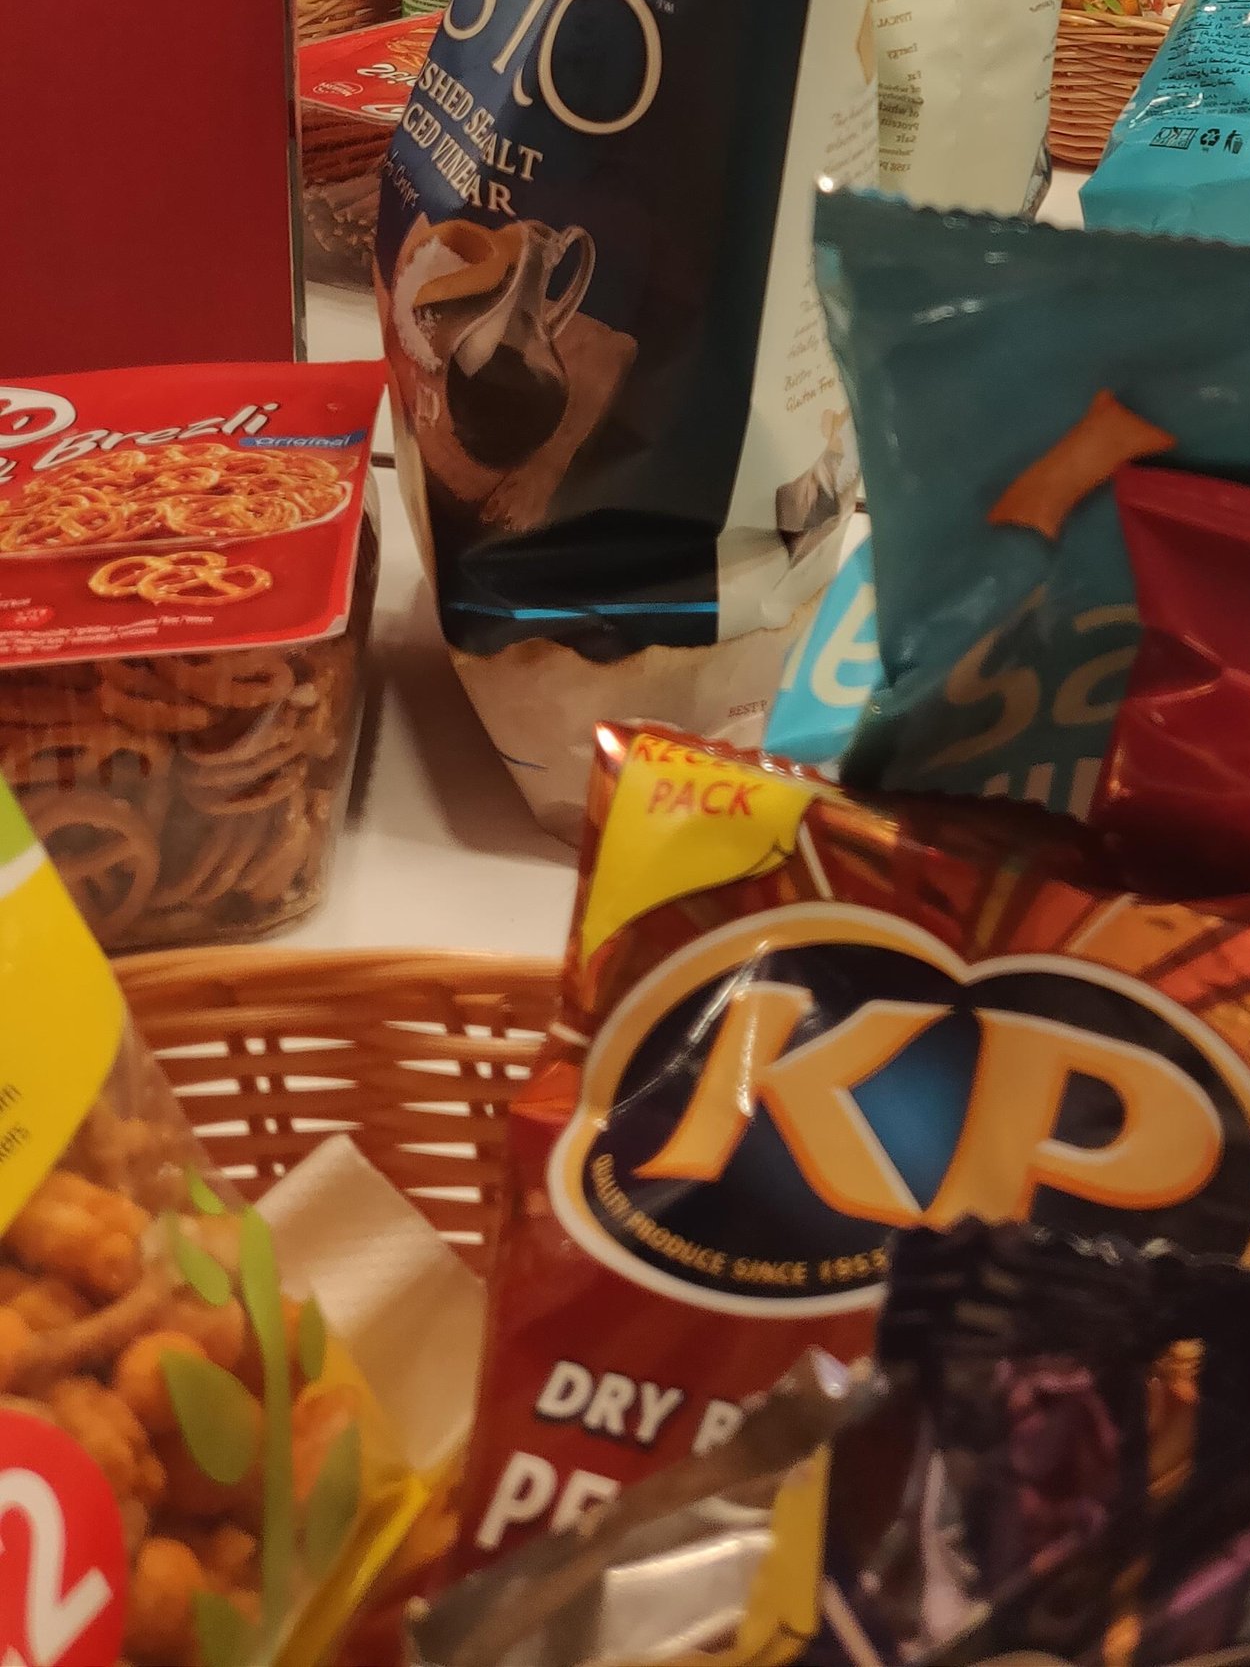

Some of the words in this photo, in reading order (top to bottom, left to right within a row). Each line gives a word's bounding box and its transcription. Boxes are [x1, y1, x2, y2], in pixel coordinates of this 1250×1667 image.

[401, 102, 442, 149] GED
[32, 402, 281, 471] Brezli
[647, 777, 766, 819] PACK
[633, 979, 1223, 1233] KP
[625, 1210, 729, 1277] PRODUCE
[729, 1257, 810, 1287] SINCE
[534, 1359, 685, 1444] DRY
